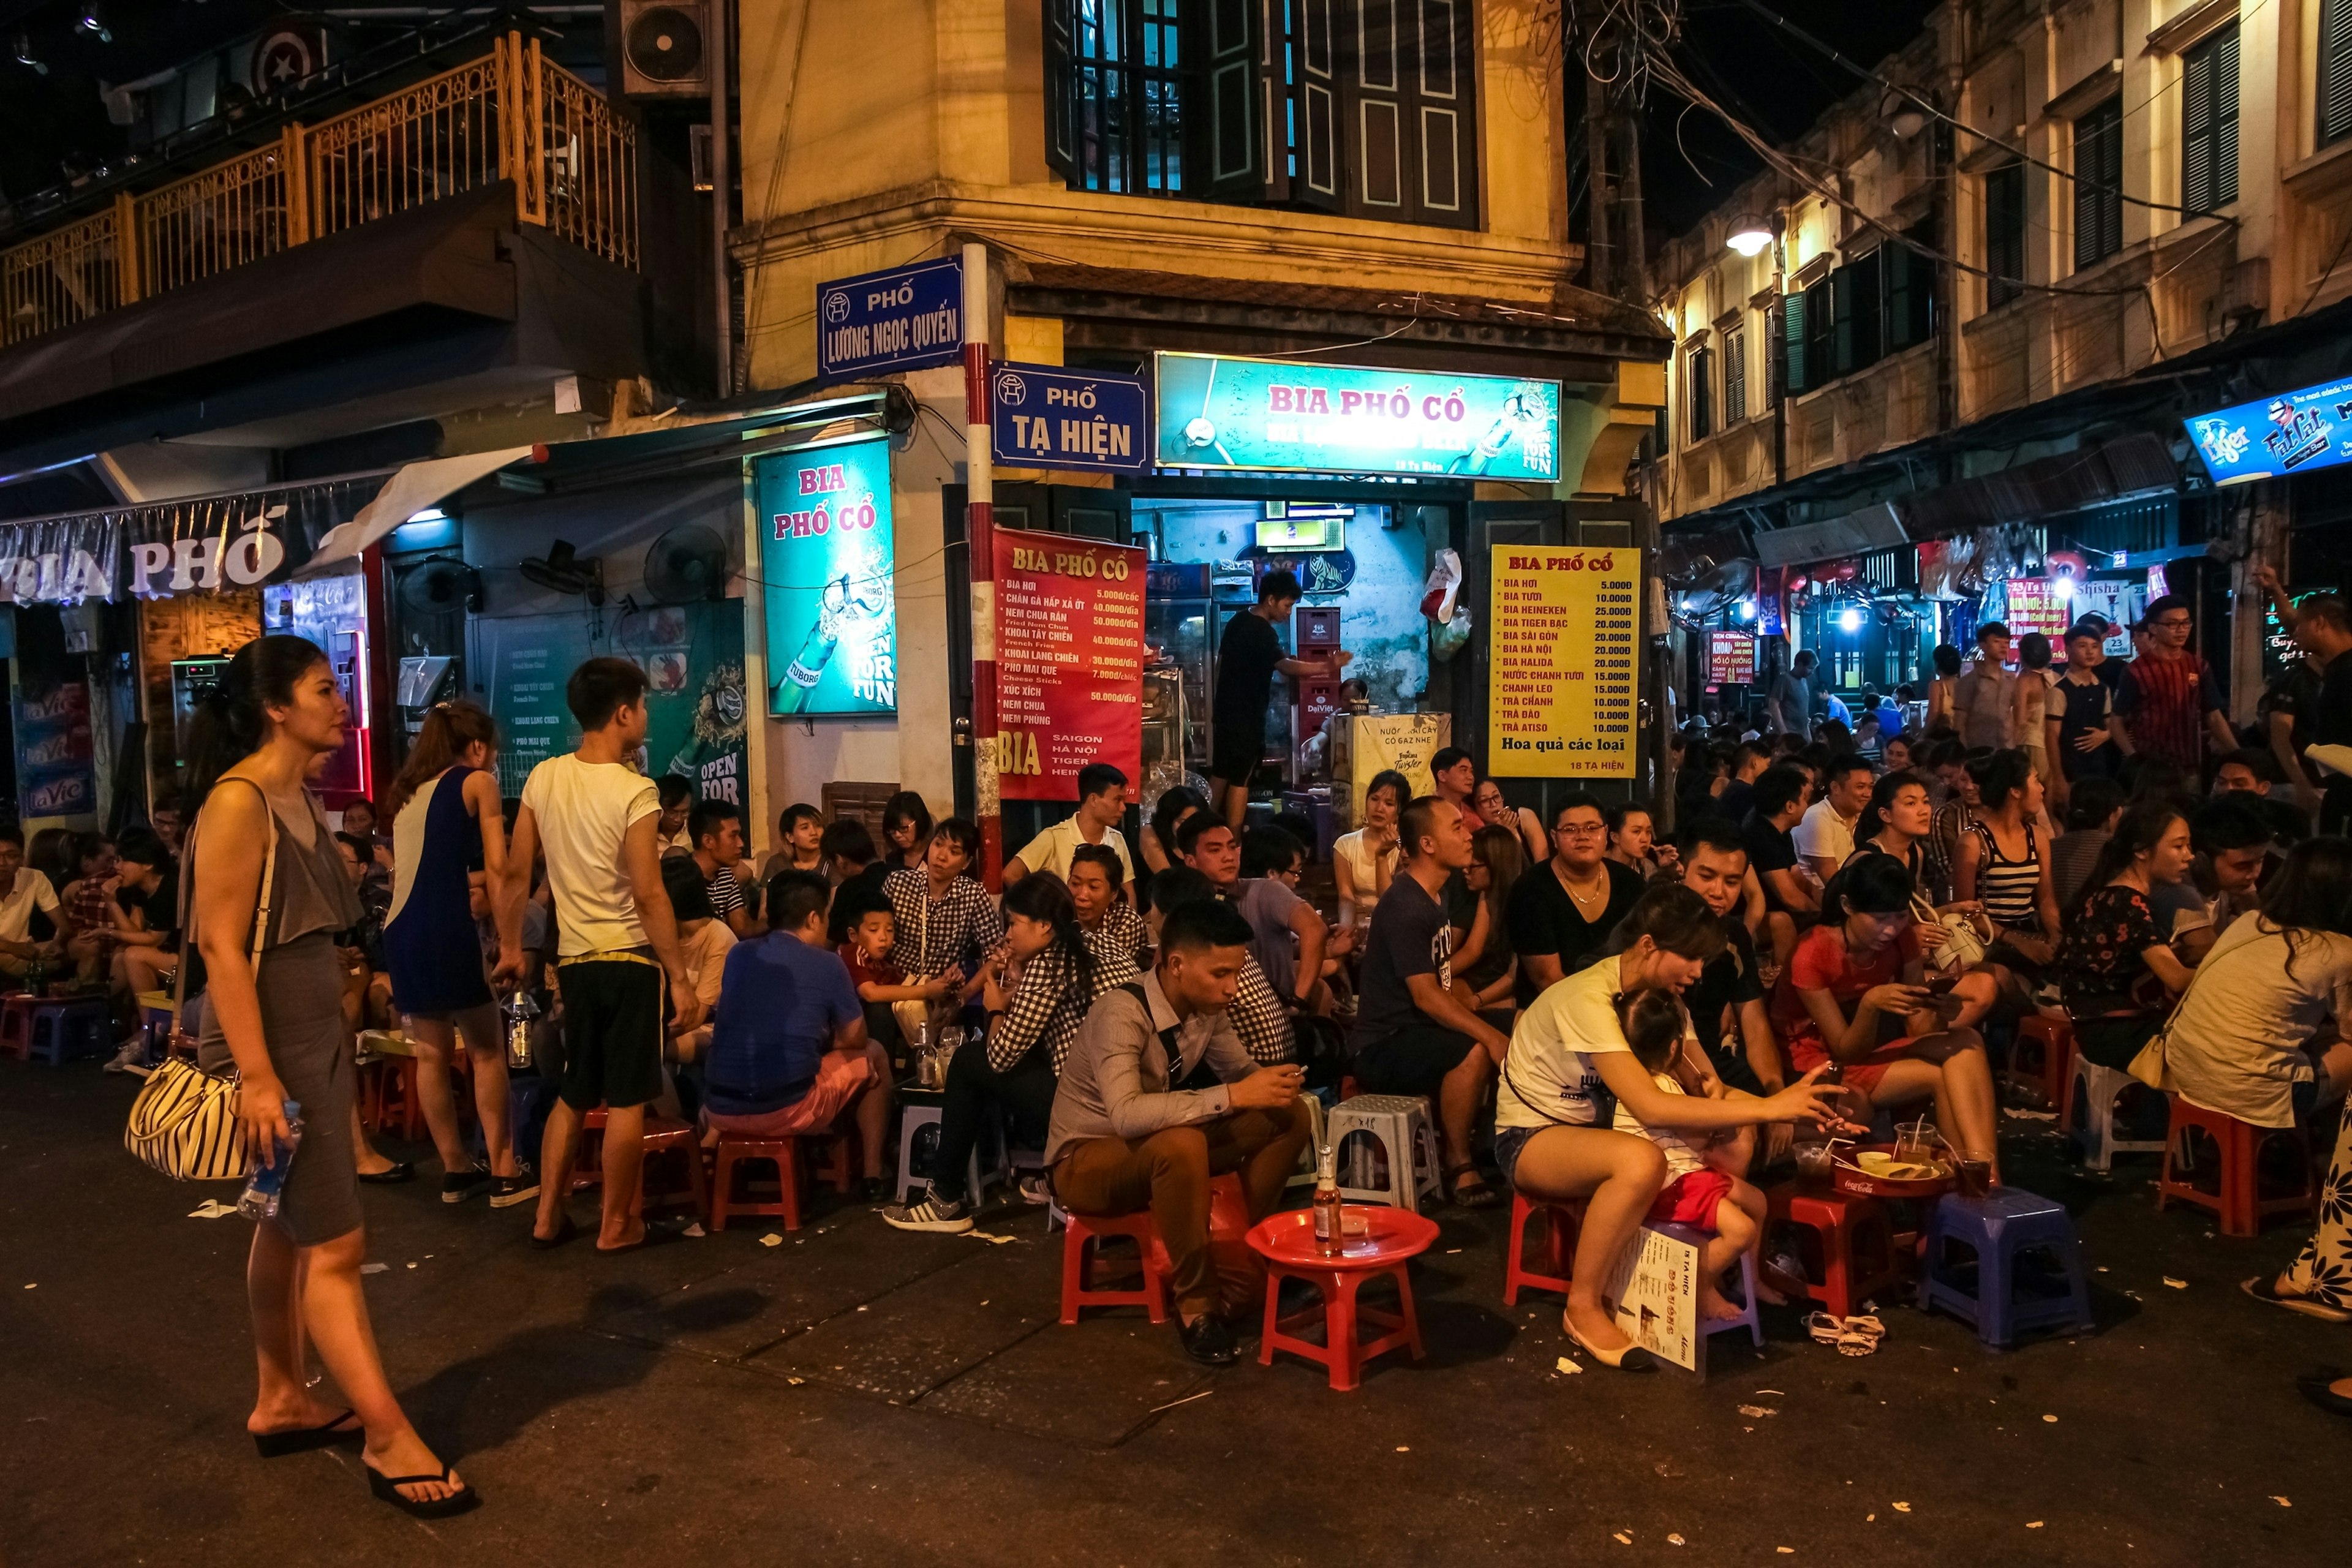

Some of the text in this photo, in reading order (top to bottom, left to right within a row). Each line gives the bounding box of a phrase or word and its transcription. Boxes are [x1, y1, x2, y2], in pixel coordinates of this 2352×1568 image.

[868, 278, 914, 311] PHỐ
[828, 299, 957, 363] LƯƠNG NGỌC QUYẾN
[1047, 384, 1097, 409] PHỐ
[1270, 386, 1464, 421] BIA PHỐ CỔ
[1012, 414, 1130, 461] TẠ HIỆN
[2311, 440, 2326, 452] Bar
[1523, 456, 1552, 475] FUN
[800, 466, 845, 494] BIA
[775, 494, 875, 539] PHỐ CỔ
[129, 505, 288, 593] PHỐ
[1012, 548, 1129, 581] BIA PHỐ CỔ
[1509, 552, 1613, 571] BIA PHỐ CỔ
[2114, 553, 2126, 565] 23
[1006, 579, 1020, 589] BIA
[1023, 581, 1036, 591] HƠI
[1504, 579, 1519, 587] BIA
[1522, 579, 1537, 588] HƠI
[2076, 582, 2120, 598] Shisha
[1006, 593, 1028, 604] CHÂN
[1030, 595, 1041, 606] GÀ
[1044, 595, 1060, 608] HẤP
[1062, 597, 1072, 609] XẢ
[1521, 592, 1542, 601] TƯƠI
[1006, 608, 1024, 618] NEM
[1026, 610, 1048, 621] CHUA
[1050, 611, 1067, 622] RÁN
[1504, 605, 1518, 614] BIA
[1521, 606, 1567, 614] HEINEKEN
[1503, 618, 1518, 627] BIA
[1521, 619, 1547, 627] TIGER
[1550, 619, 1568, 630] BẠC
[1005, 627, 1030, 638] KHOAI
[1032, 628, 1046, 640] TÂY
[1503, 631, 1518, 640] BIA
[1521, 630, 1536, 640] SÀI
[1539, 630, 1558, 641] GÒN
[1503, 644, 1518, 653] BIA
[1521, 643, 1533, 653] HÀ
[1536, 643, 1551, 655] NỘI
[1713, 641, 1731, 654] KHOAI
[2271, 638, 2293, 651] Buy
[1005, 649, 1029, 659] KHOAI
[1031, 650, 1053, 662] LANG
[1521, 658, 1553, 666] HALIDA
[790, 663, 818, 683] TUBORG
[1005, 662, 1020, 673] PHO
[1023, 664, 1039, 674] MAI
[1041, 665, 1057, 676] QUE
[1502, 669, 1528, 679] NƯỚC
[1530, 671, 1561, 680] CHANH
[1564, 671, 1584, 680] TƯƠI
[853, 678, 895, 707] FUN
[1003, 684, 1020, 695] XÚC
[1022, 685, 1041, 696] XÍCH
[1502, 684, 1533, 693] CHANH
[1003, 699, 1046, 711] NEM CHUA
[1502, 695, 1519, 706] TRÀ
[1003, 714, 1021, 723] NEM
[1502, 709, 1519, 718] TRÀ
[1521, 709, 1540, 718] ĐÀO
[1502, 722, 1518, 731] TRÀ
[1521, 723, 1548, 732] ATISO
[1052, 734, 1102, 744] SAIGON
[1502, 736, 1625, 753] Hoa quả các loại
[998, 730, 1042, 775] BIA
[1052, 745, 1097, 756] HÀ NỘI
[701, 752, 738, 780] OPEN
[1395, 759, 1422, 771] Twister
[1585, 762, 1598, 772] TẠ
[1601, 760, 1624, 772] HIỆN
[702, 777, 739, 806] FOR
